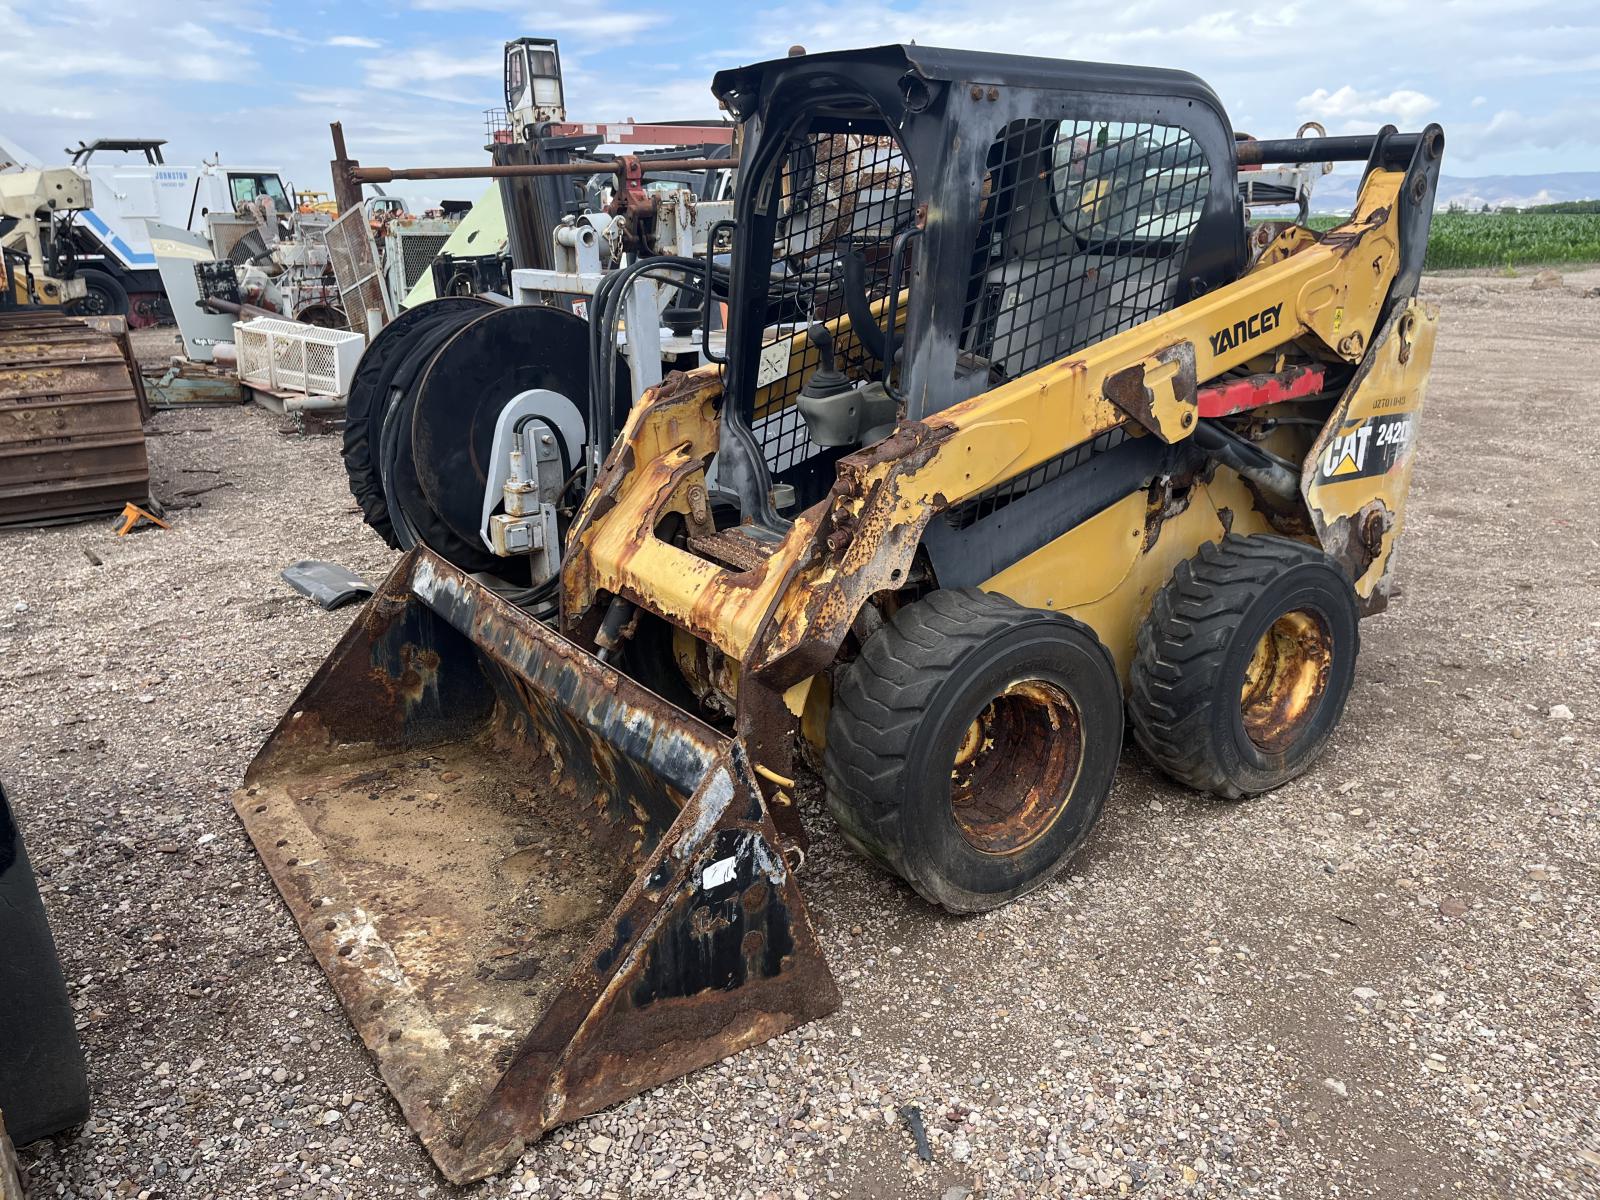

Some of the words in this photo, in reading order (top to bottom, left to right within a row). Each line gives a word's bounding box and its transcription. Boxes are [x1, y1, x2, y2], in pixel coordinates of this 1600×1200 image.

[155, 171, 188, 180] JOHNSTON
[1209, 302, 1283, 357] YANCEY
[1323, 426, 1373, 477] CAT
[1376, 420, 1410, 447] 242D
